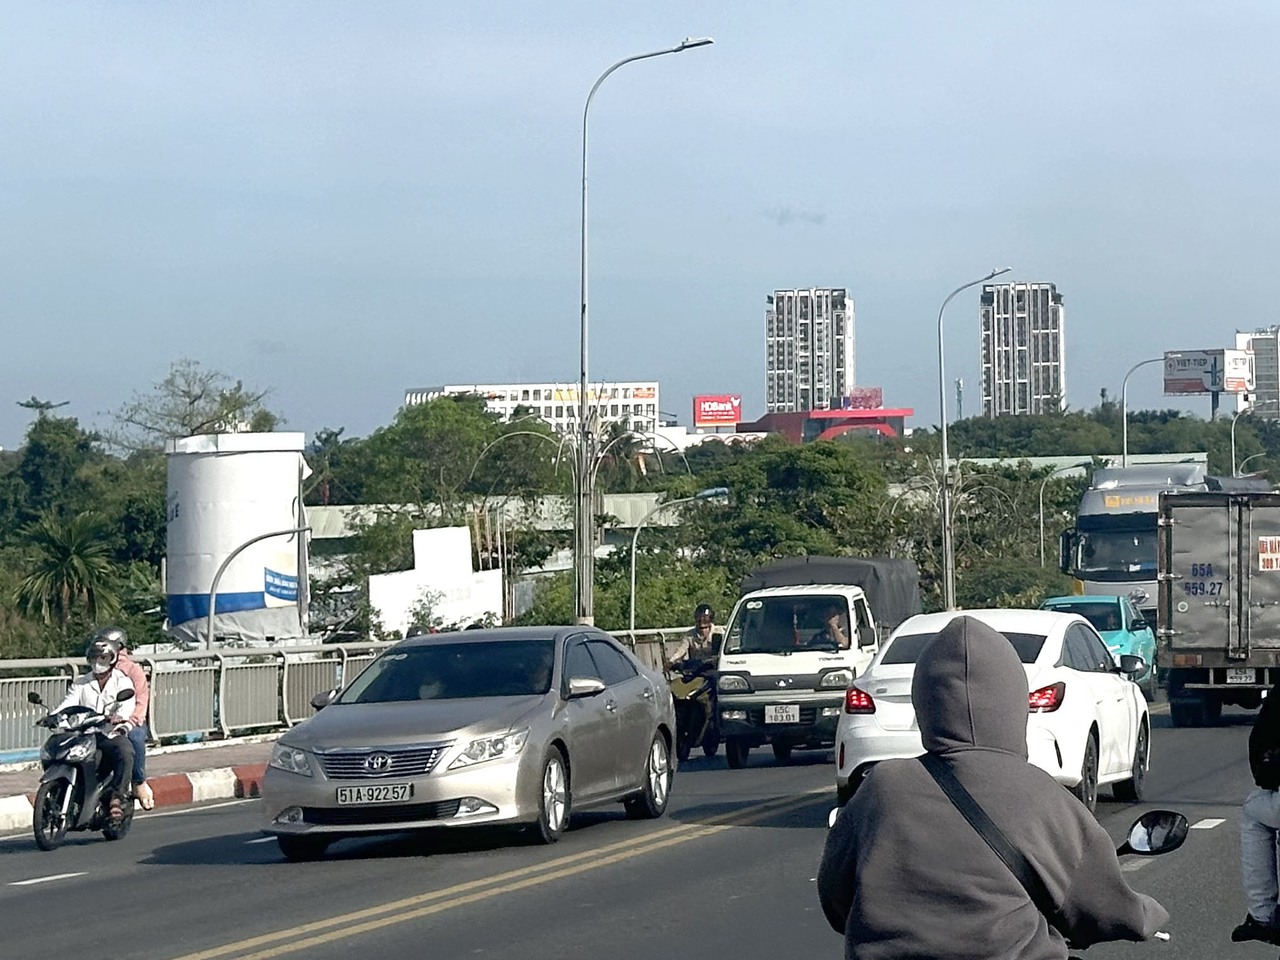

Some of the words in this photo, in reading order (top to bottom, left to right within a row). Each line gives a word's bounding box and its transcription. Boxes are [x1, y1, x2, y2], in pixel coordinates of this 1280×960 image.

[701, 401, 732, 411] HDBank
[1191, 563, 1214, 577] 65A
[1184, 582, 1223, 596] 559.27
